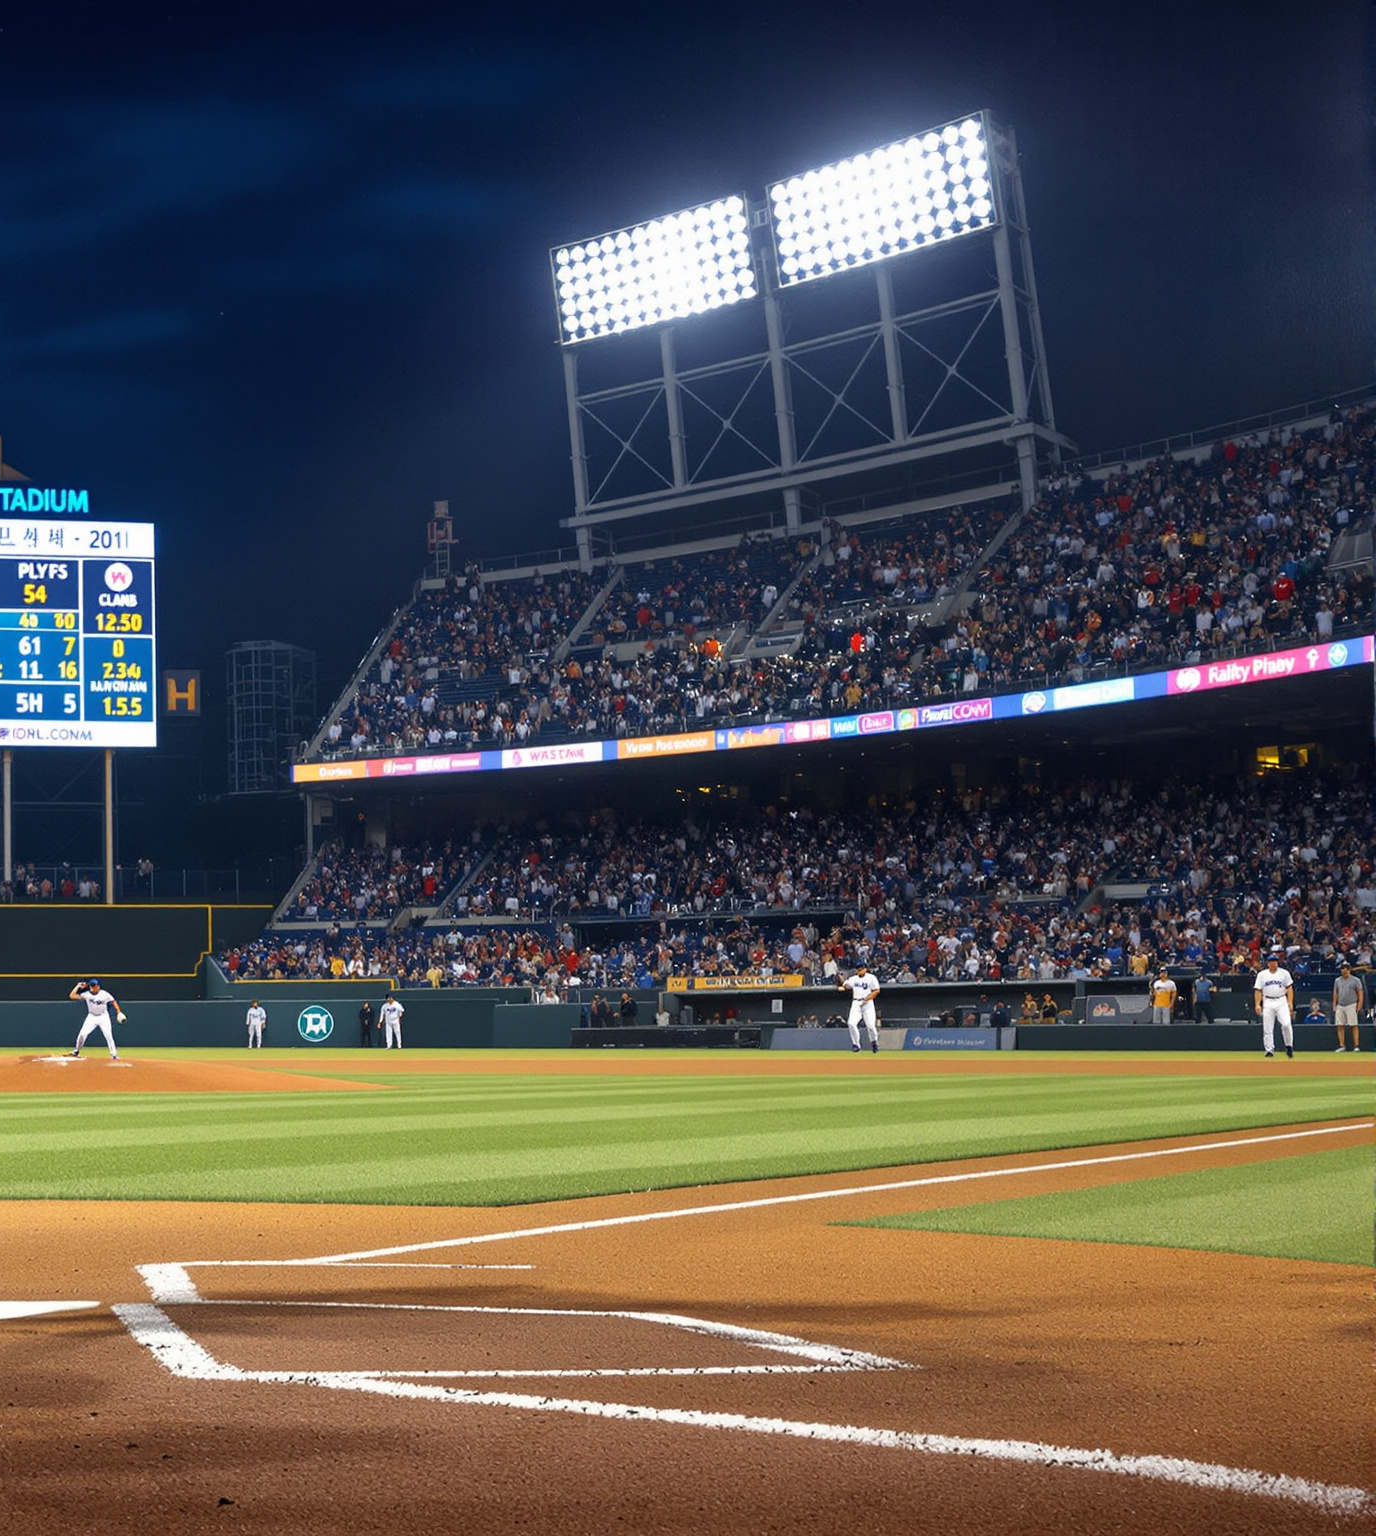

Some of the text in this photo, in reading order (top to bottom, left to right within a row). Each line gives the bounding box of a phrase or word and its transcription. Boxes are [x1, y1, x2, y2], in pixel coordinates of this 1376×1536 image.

[24, 584, 47, 604] 54
[18, 636, 41, 655] 61
[63, 637, 76, 656] 7
[58, 660, 78, 680] 16
[15, 692, 44, 714] 5H
[63, 693, 78, 714] 5
[167, 677, 196, 711] H
